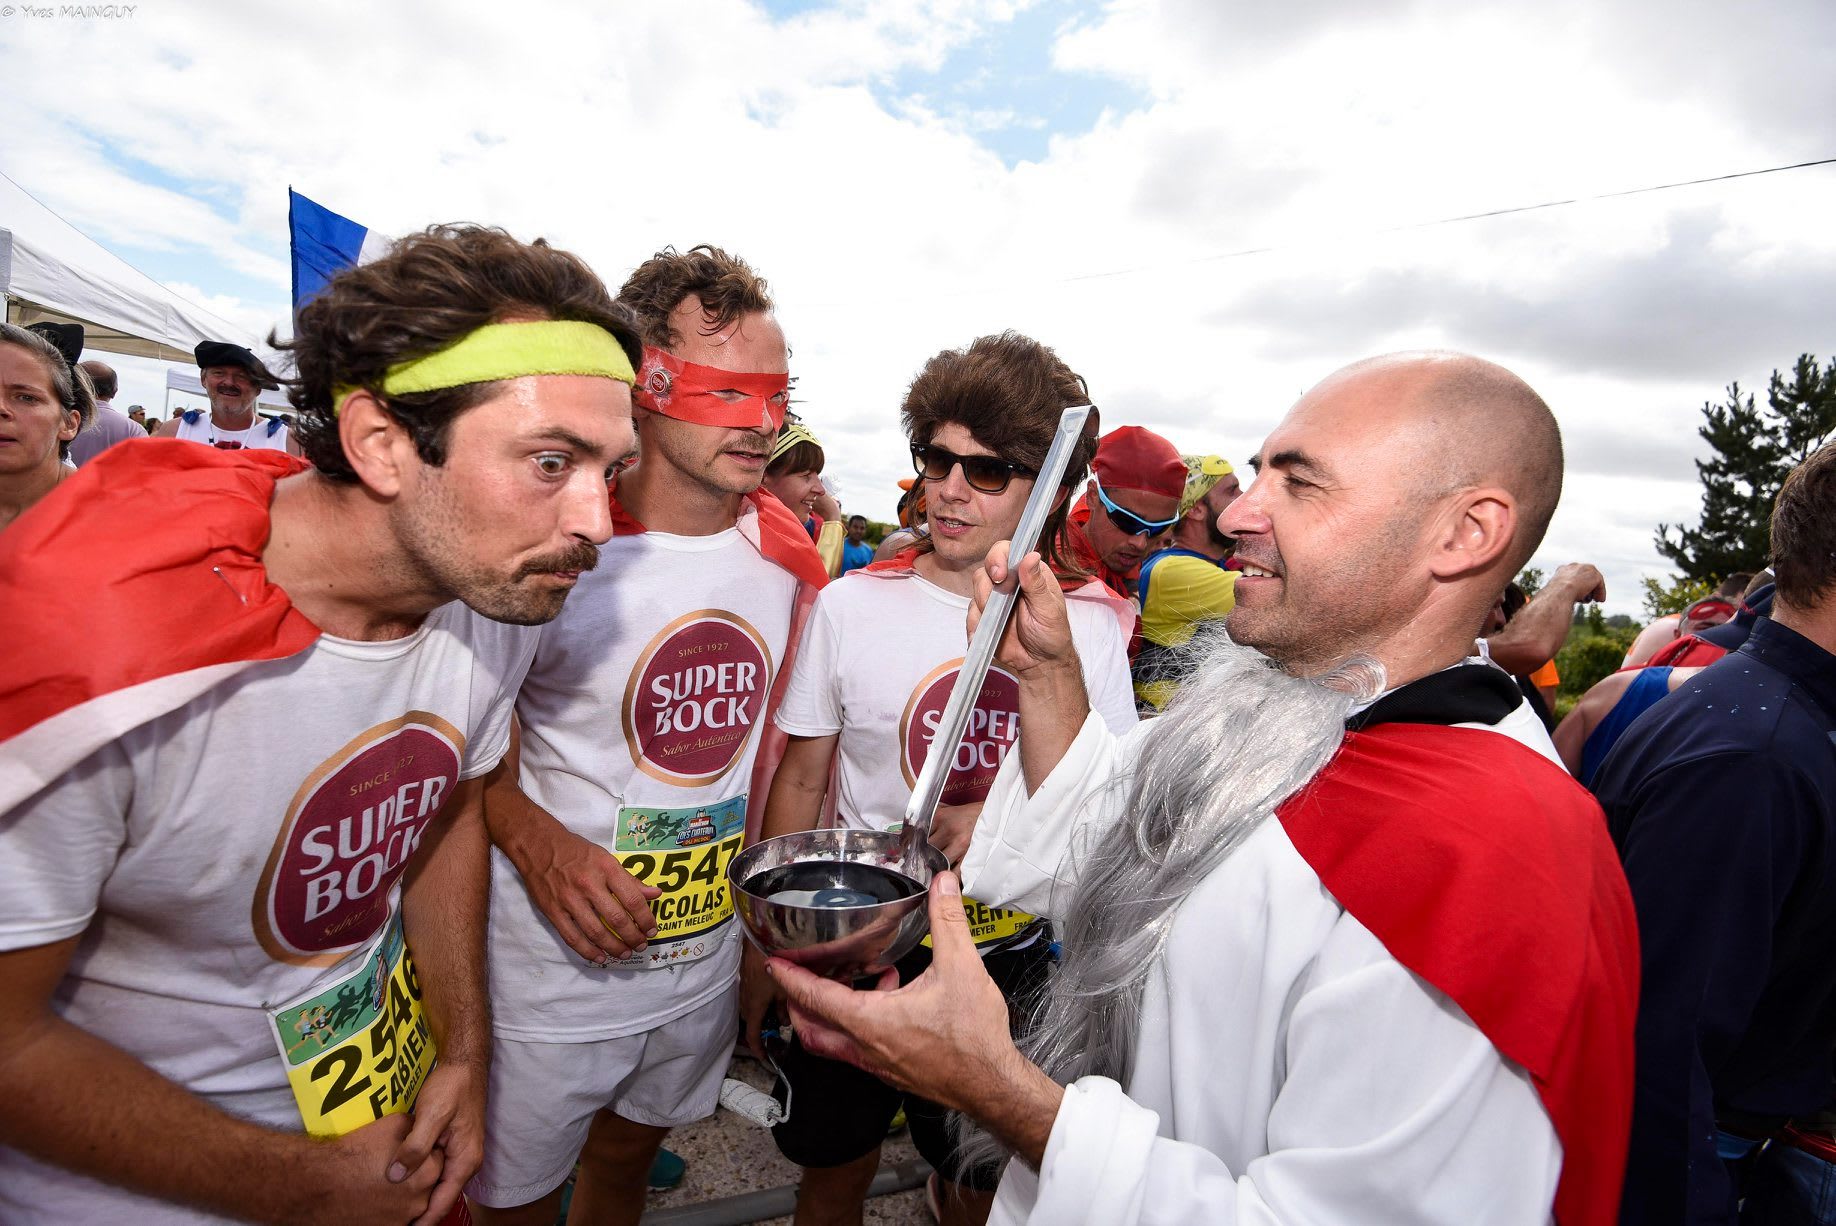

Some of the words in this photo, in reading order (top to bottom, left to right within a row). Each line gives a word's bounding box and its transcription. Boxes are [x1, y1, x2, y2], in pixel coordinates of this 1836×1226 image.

[678, 645, 703, 657] SINCE
[707, 643, 729, 652] 1927
[651, 662, 757, 708] SUPER
[654, 696, 750, 736] BOCK
[922, 708, 1020, 741] SPER
[660, 743, 691, 758] Sabor
[350, 771, 391, 797] SINCE
[300, 776, 447, 875] SUPER
[304, 819, 430, 923] BOCK
[621, 837, 742, 893] 2547
[657, 920, 684, 931] SAINT
[311, 949, 421, 1117] 2546
[369, 1013, 429, 1120] FABIEN
